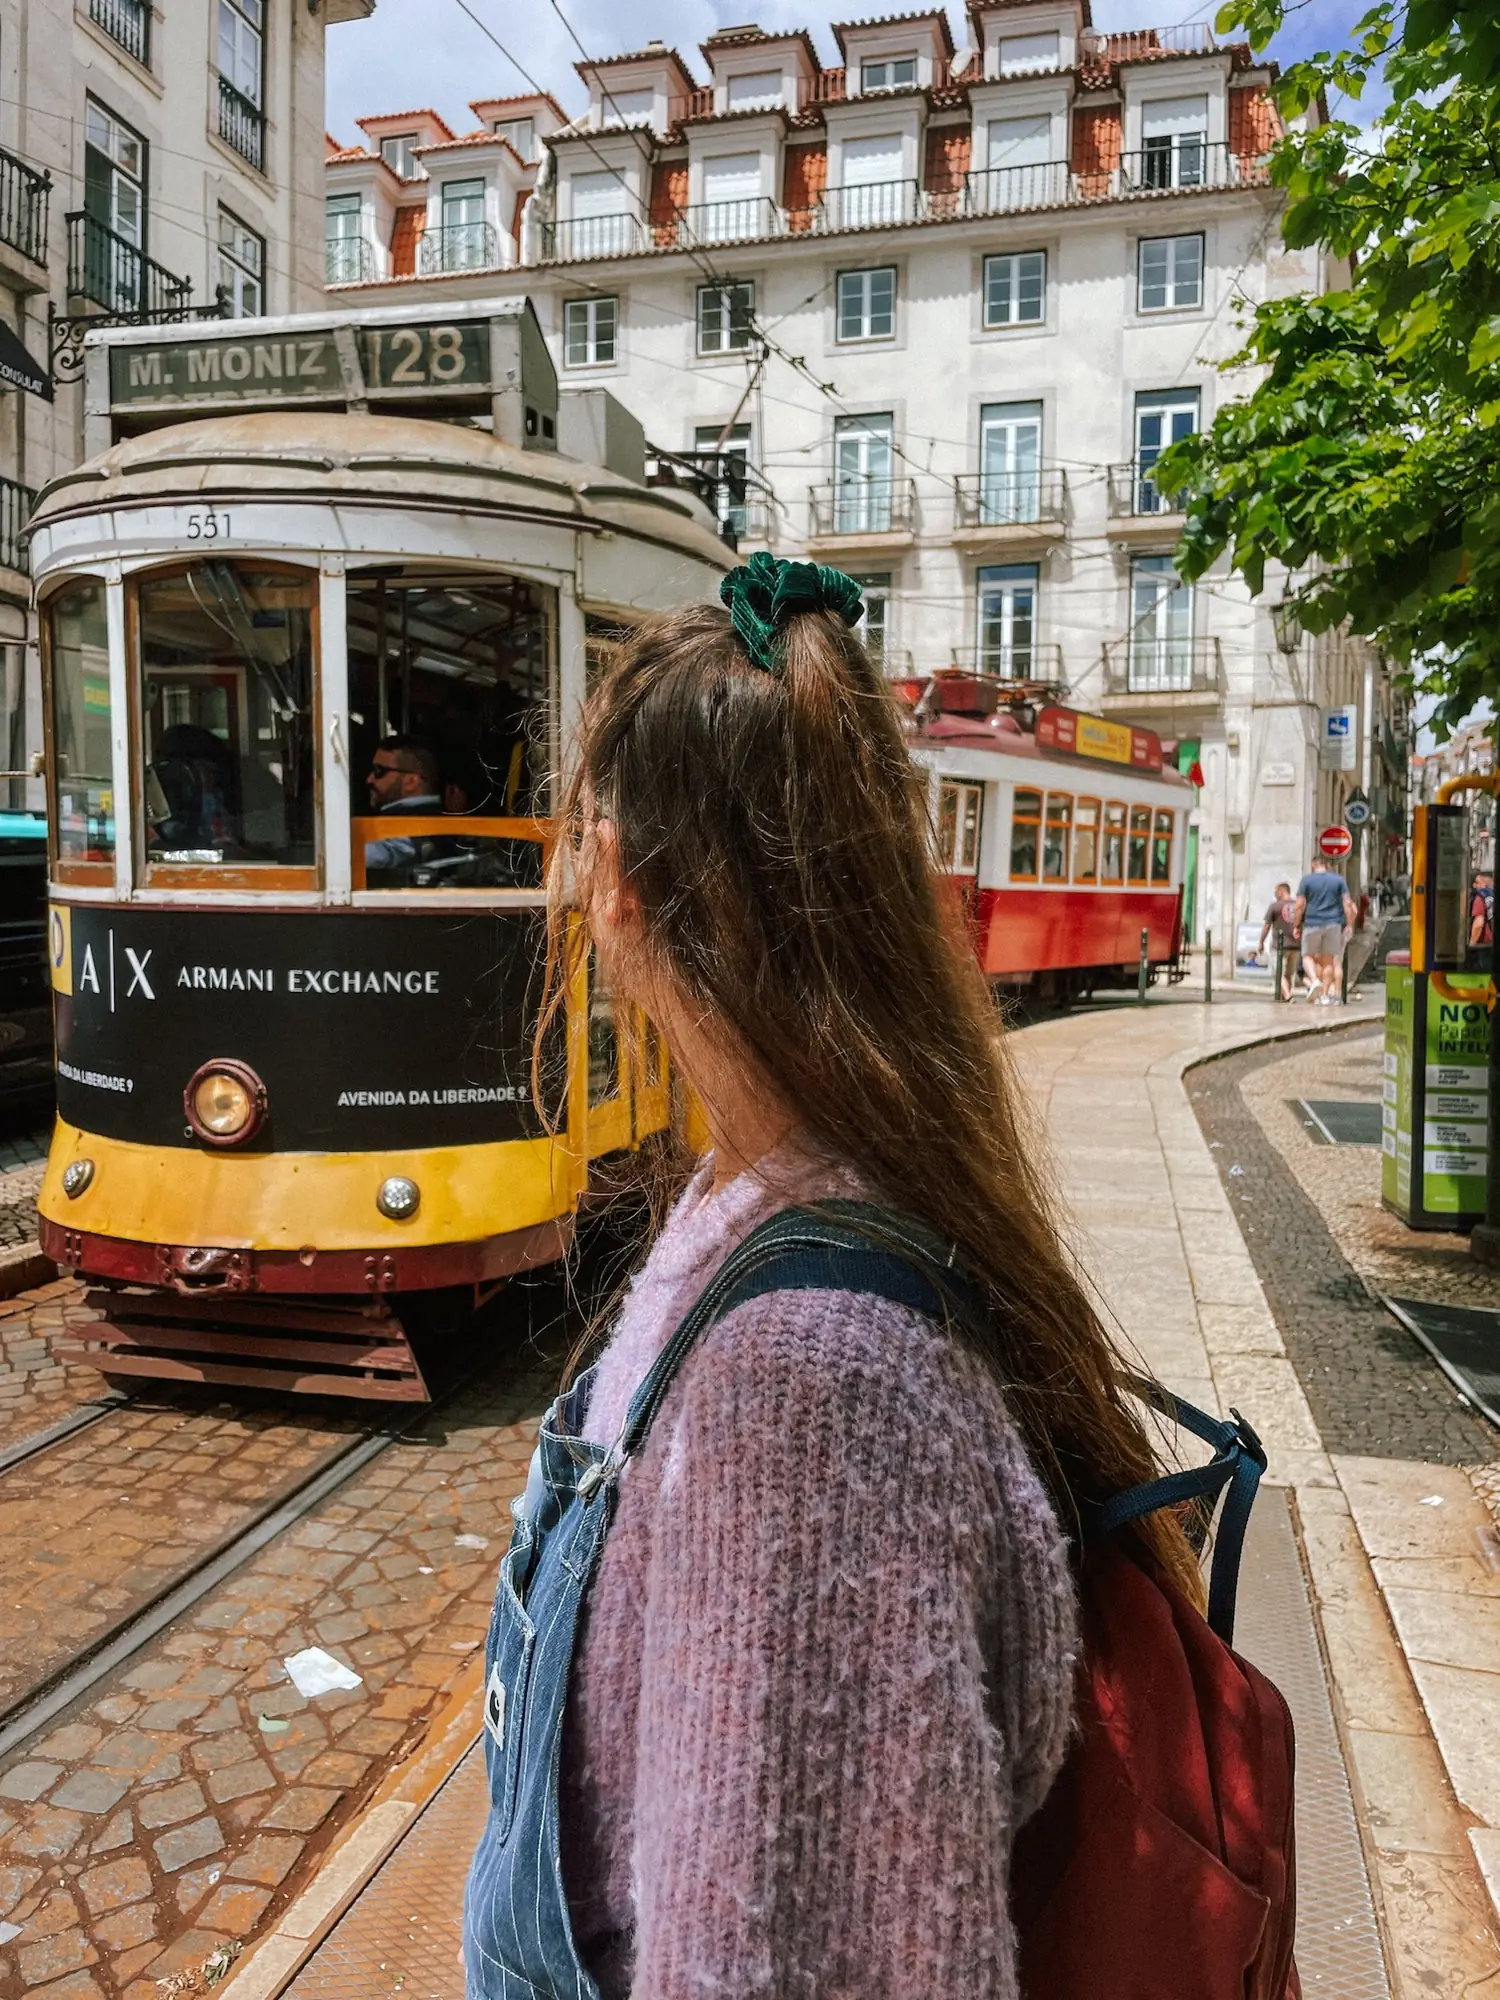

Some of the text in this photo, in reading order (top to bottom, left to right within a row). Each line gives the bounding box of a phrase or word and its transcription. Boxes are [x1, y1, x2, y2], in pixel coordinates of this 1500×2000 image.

[129, 340, 327, 387] M. MONIZ
[187, 513, 230, 539] 551
[177, 965, 440, 994] ARMANI EXCHANGE
[337, 1085, 527, 1107] AVENIDA DA LIBERDADE 9
